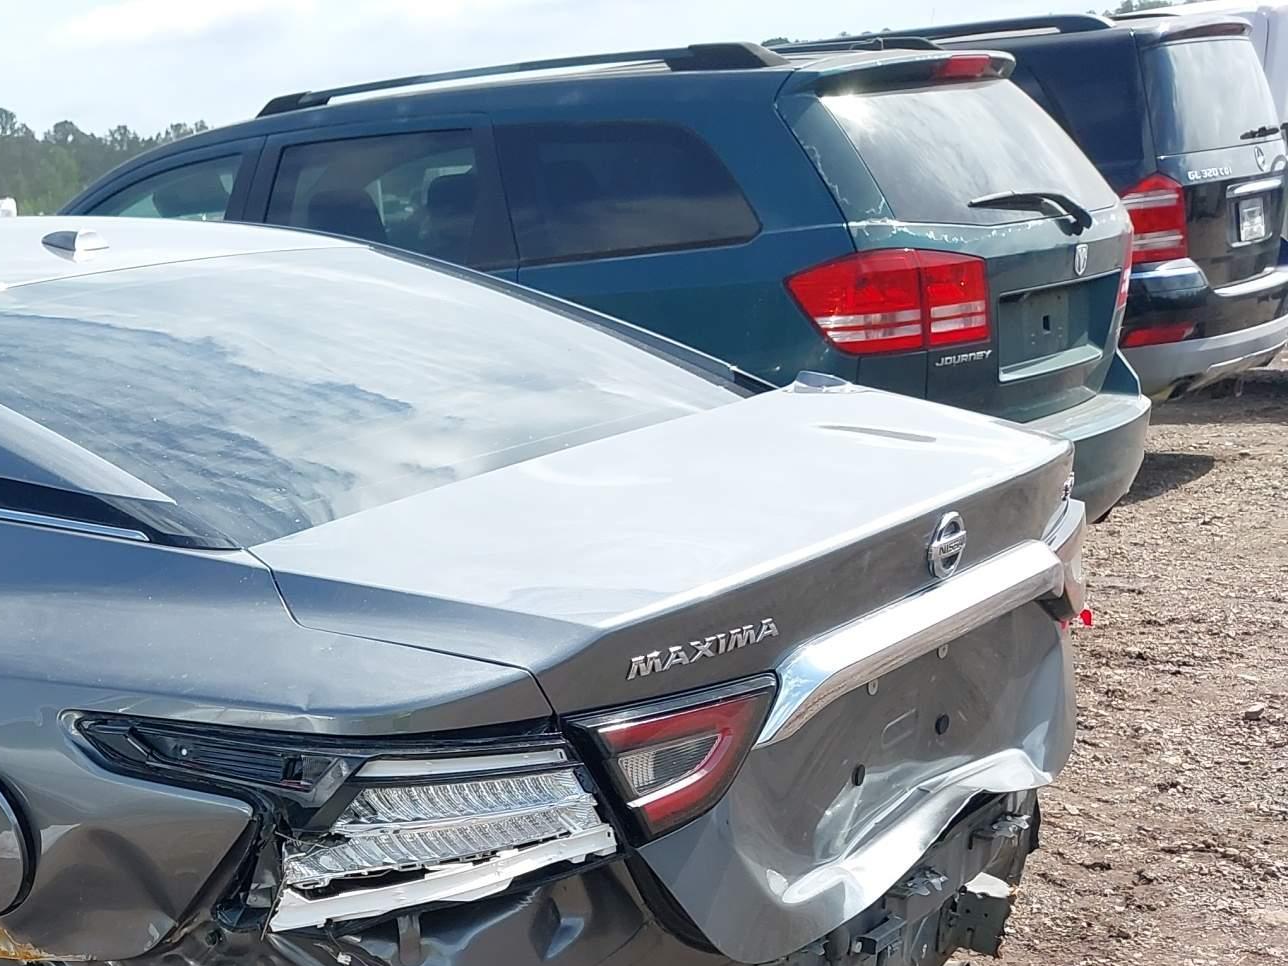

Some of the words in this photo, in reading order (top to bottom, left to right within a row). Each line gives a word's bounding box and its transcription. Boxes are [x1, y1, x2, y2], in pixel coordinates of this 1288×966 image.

[1188, 170, 1201, 180] GL
[1202, 168, 1218, 178] 320
[935, 350, 992, 367] JOURNEY
[626, 617, 780, 681] MAXIMA
